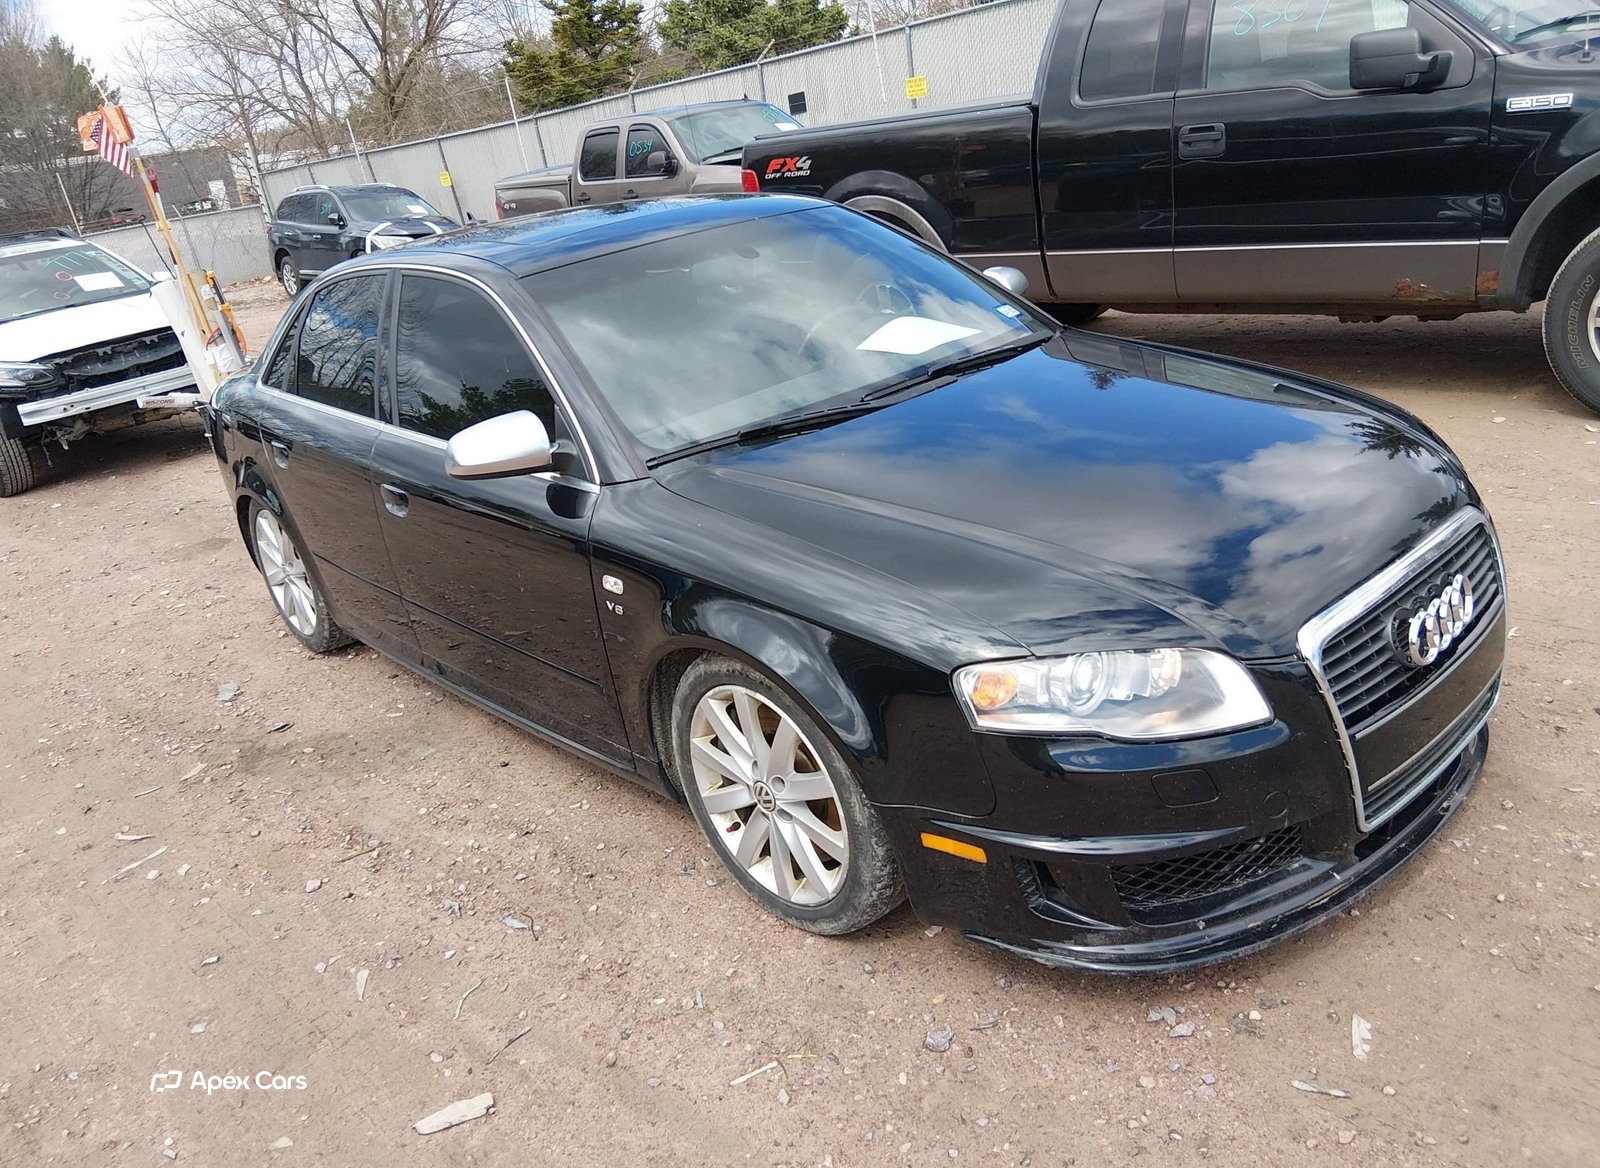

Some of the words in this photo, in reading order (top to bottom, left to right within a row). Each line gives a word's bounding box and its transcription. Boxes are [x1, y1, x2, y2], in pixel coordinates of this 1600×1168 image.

[629, 139, 653, 157] 0534
[766, 155, 812, 174] FX4
[764, 172, 782, 180] OFF
[783, 169, 811, 178] ROAD
[1567, 274, 1594, 369] MICHELIN
